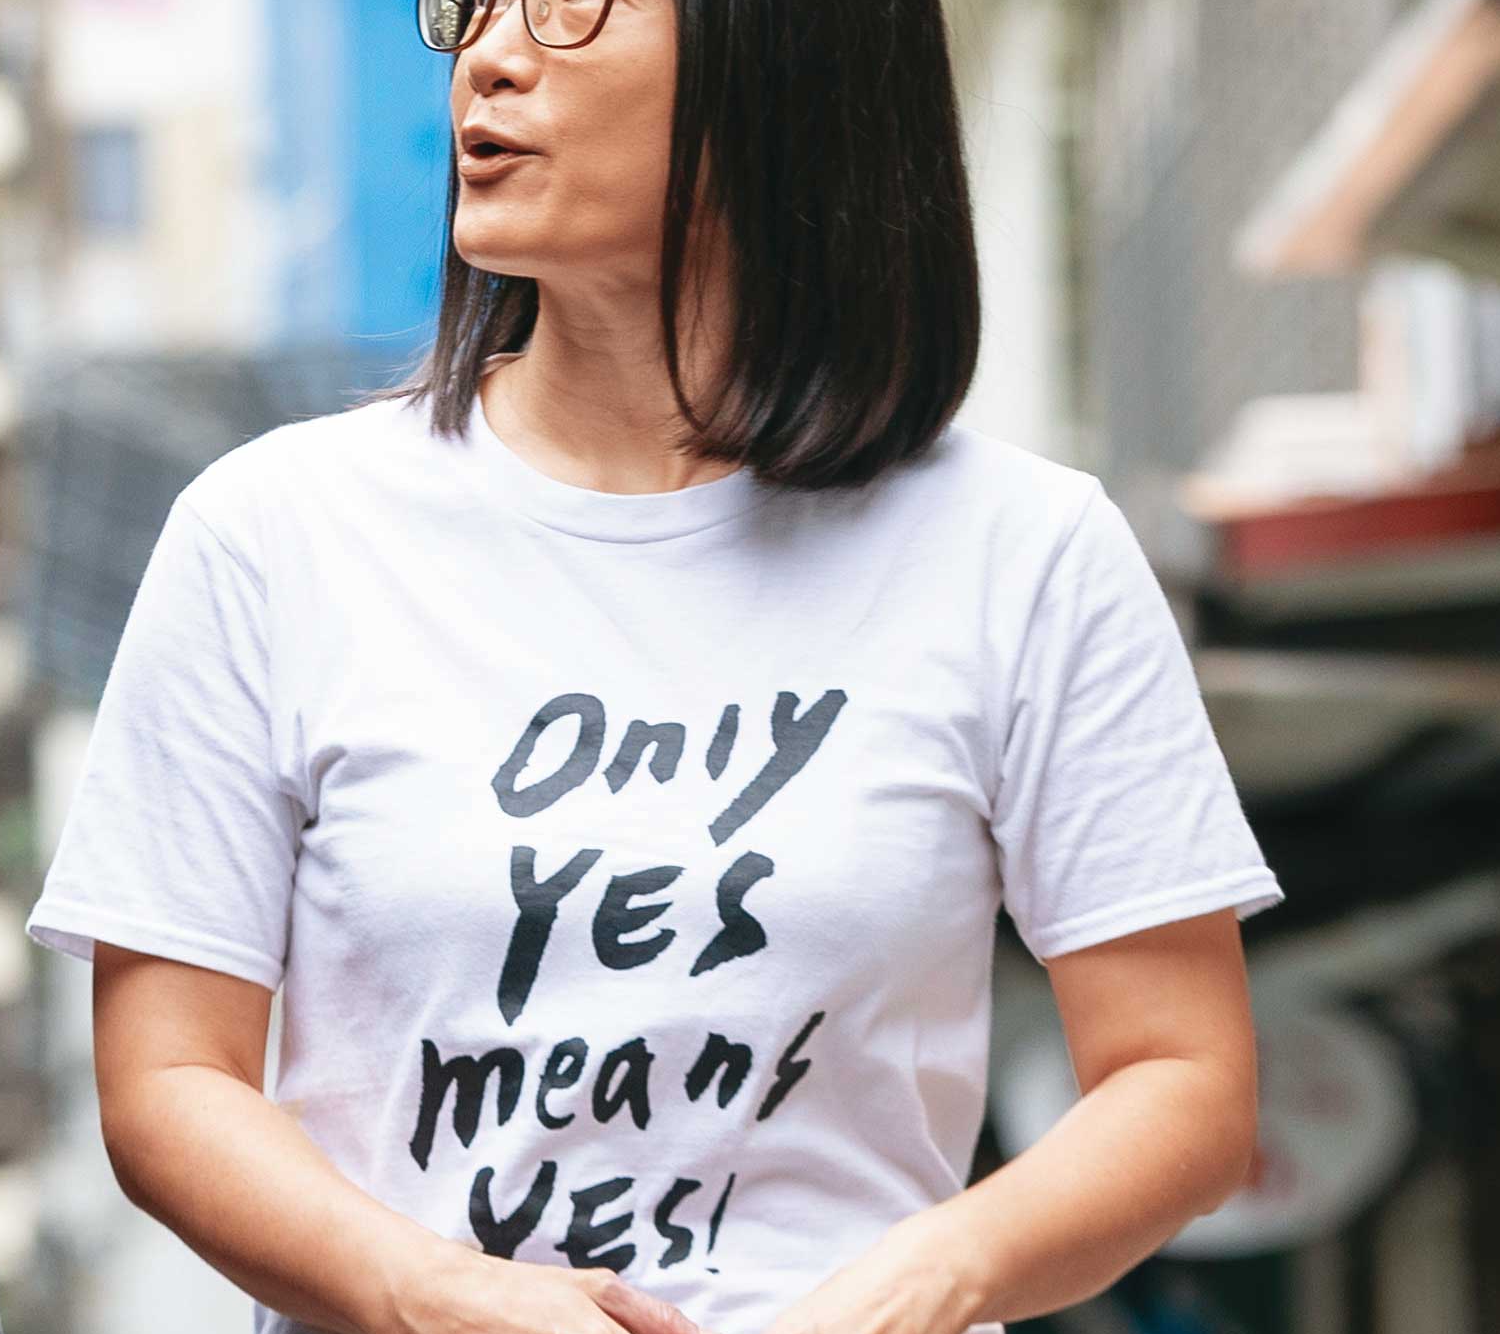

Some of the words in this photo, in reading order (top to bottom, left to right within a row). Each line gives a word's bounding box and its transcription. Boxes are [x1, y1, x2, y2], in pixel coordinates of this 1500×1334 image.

[491, 689, 848, 846] Only
[497, 845, 775, 1026] YES
[409, 1011, 826, 1171] means
[468, 1160, 736, 1273] YES!
